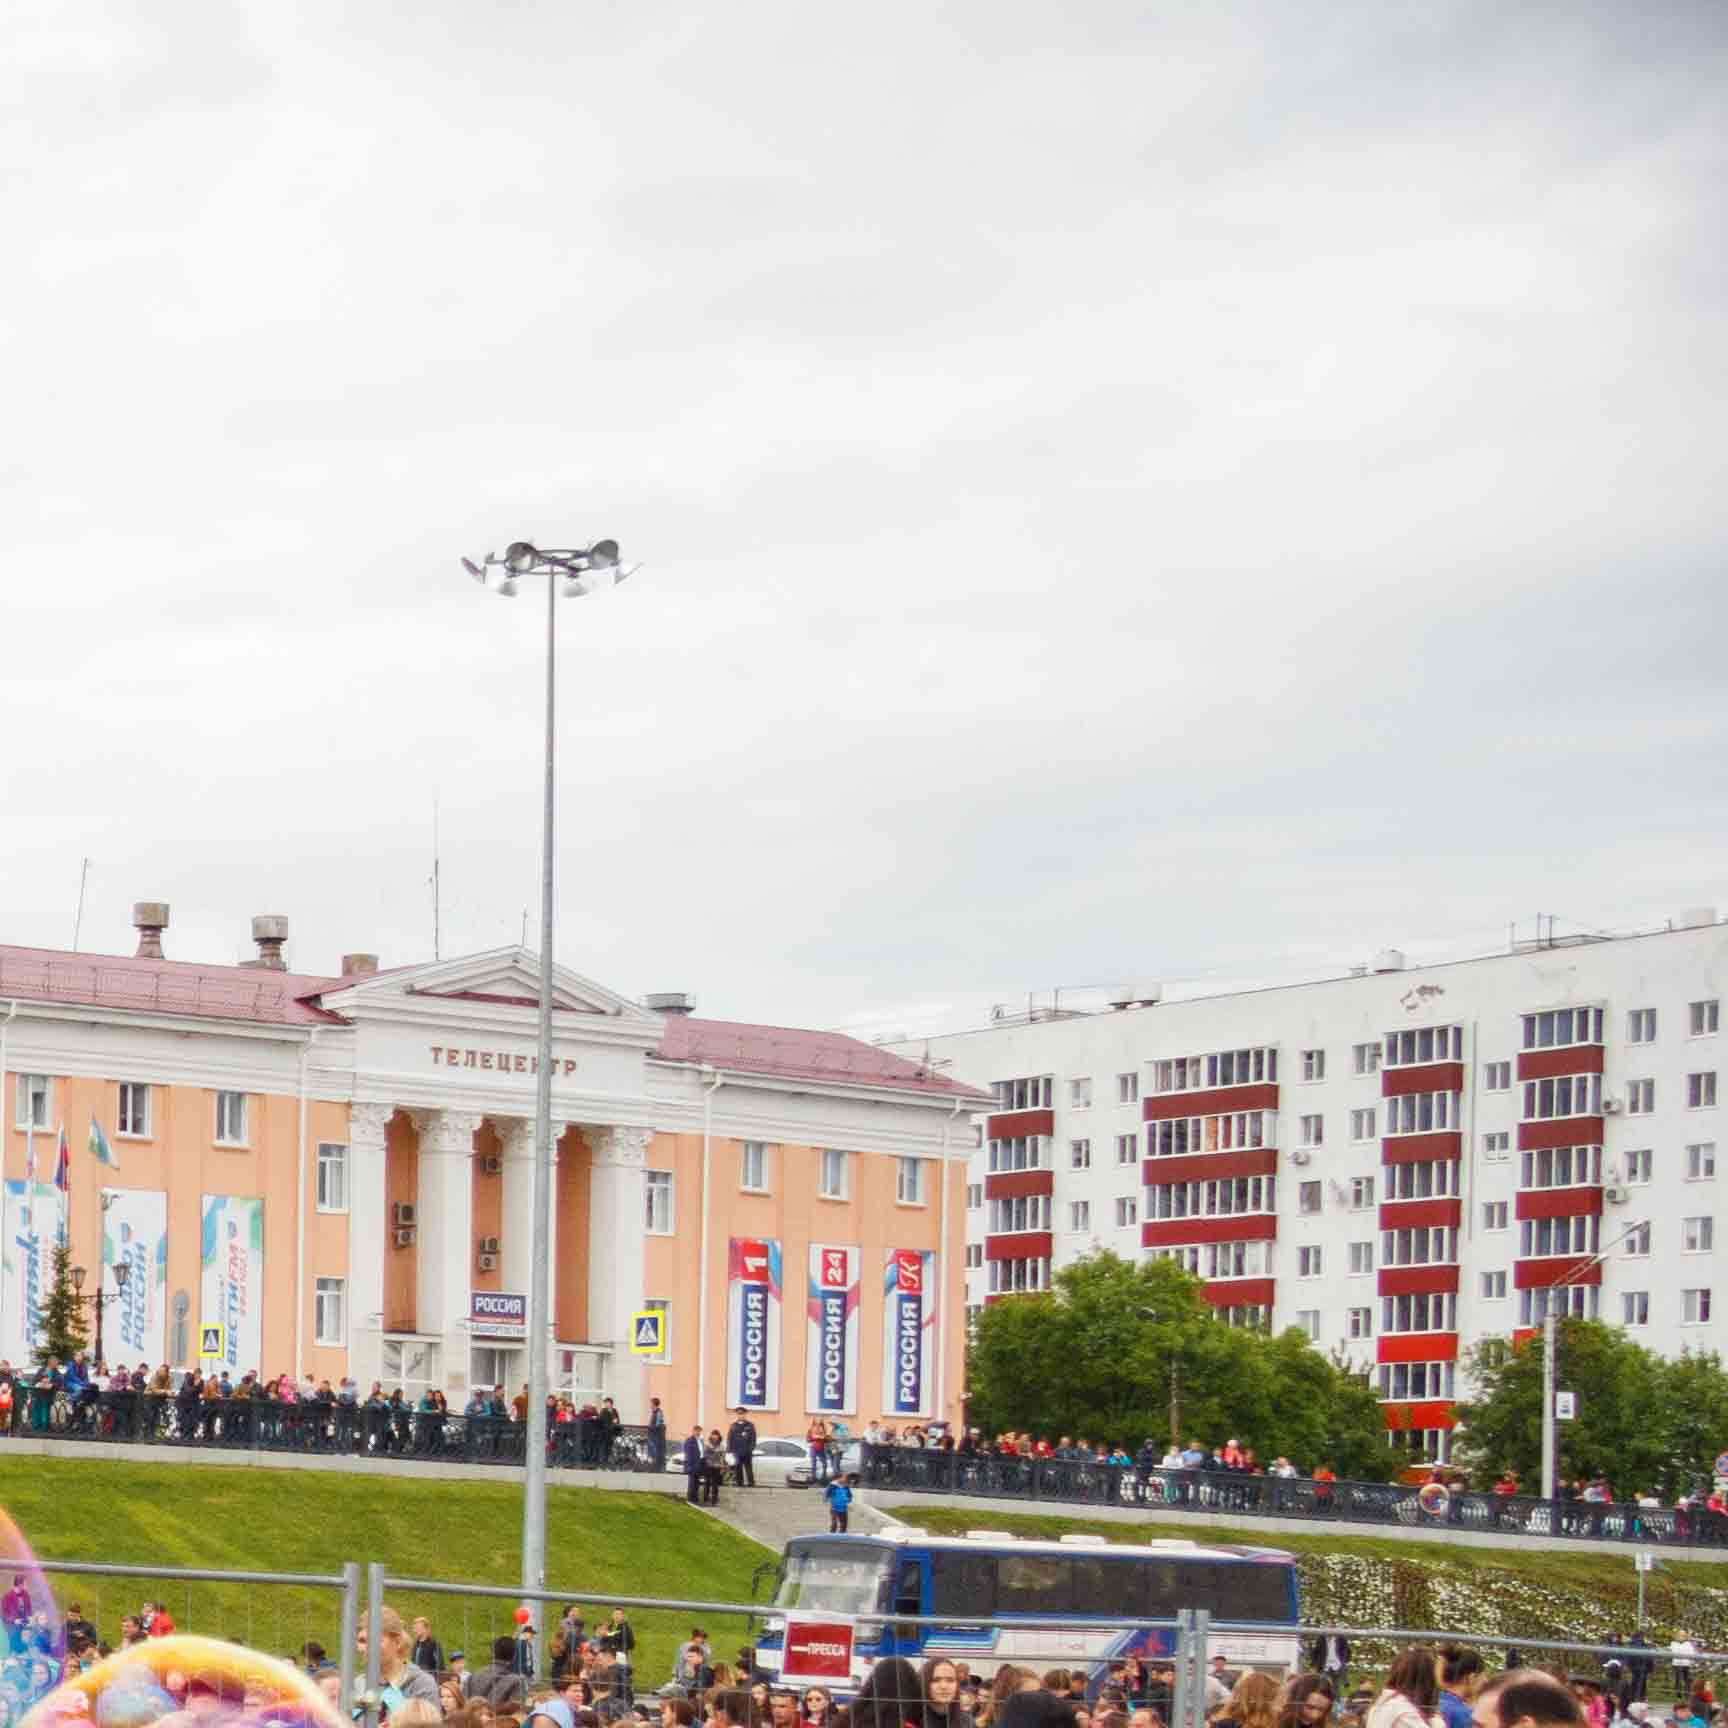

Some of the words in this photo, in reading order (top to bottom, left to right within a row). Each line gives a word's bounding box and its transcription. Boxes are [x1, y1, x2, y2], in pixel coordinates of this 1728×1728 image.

[743, 1256, 768, 1273] 1
[826, 1252, 843, 1282] 24
[475, 1297, 521, 1314] РОССИЯ
[745, 1292, 763, 1396] РОССИЯ
[823, 1297, 842, 1400] РОССИЯ
[899, 1301, 918, 1403] РОССИЯ
[807, 1642, 846, 1657] ПРЕССА
